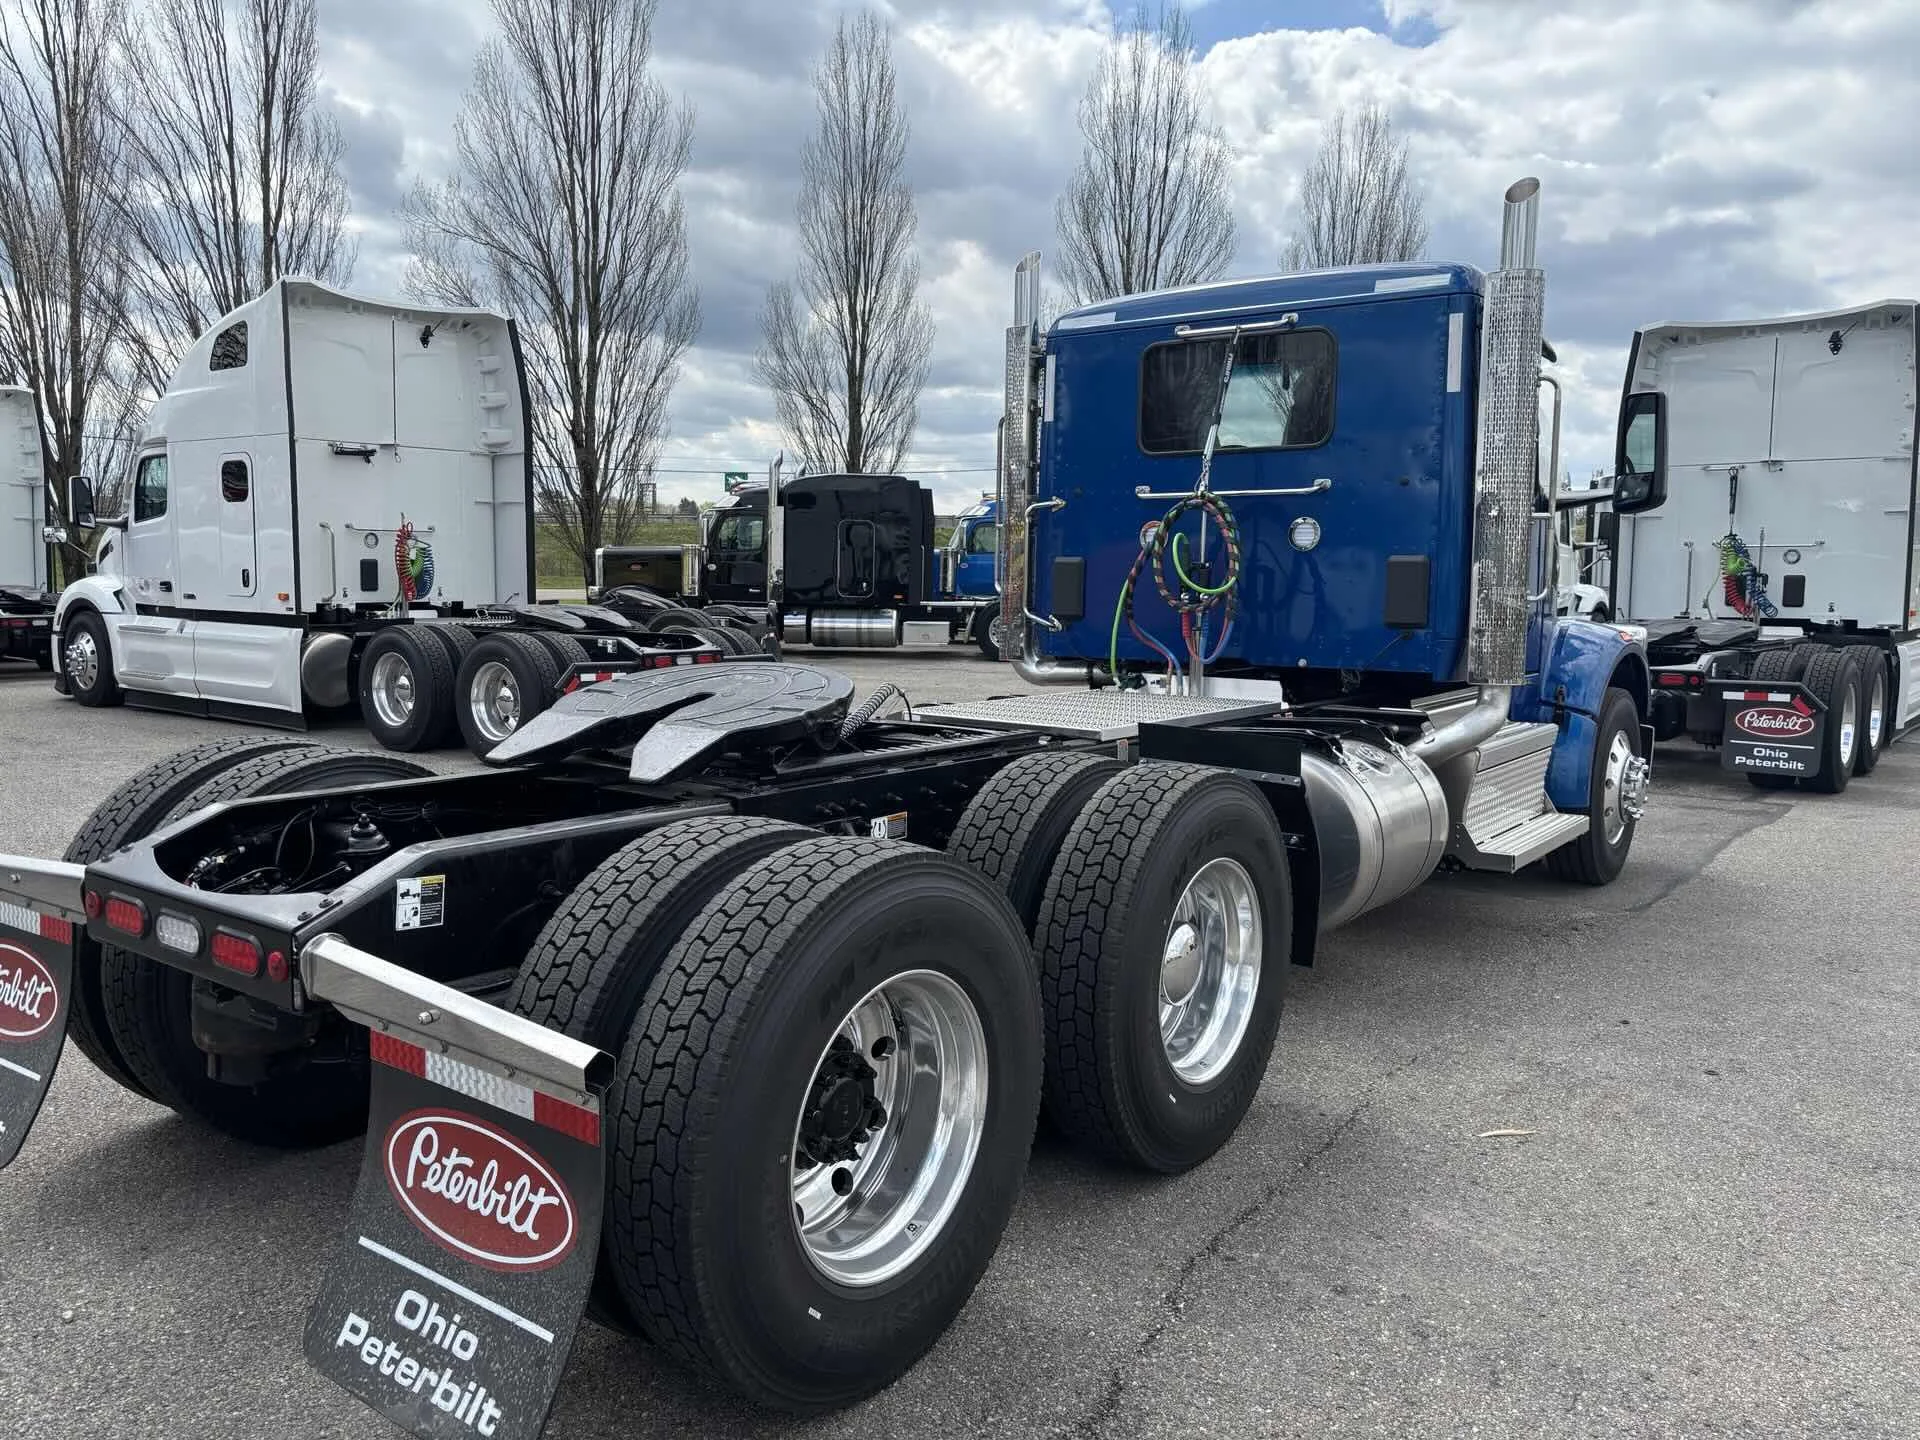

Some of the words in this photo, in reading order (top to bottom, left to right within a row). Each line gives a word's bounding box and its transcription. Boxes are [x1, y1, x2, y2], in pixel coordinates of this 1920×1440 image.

[1744, 711, 1808, 730] Peterbilt
[1735, 755, 1805, 770] Peterbilt
[1753, 747, 1789, 759] Ohio
[406, 1126, 560, 1240] Peterbilt
[395, 1289, 479, 1361] Ohio
[335, 1312, 502, 1437] Peterbilt
